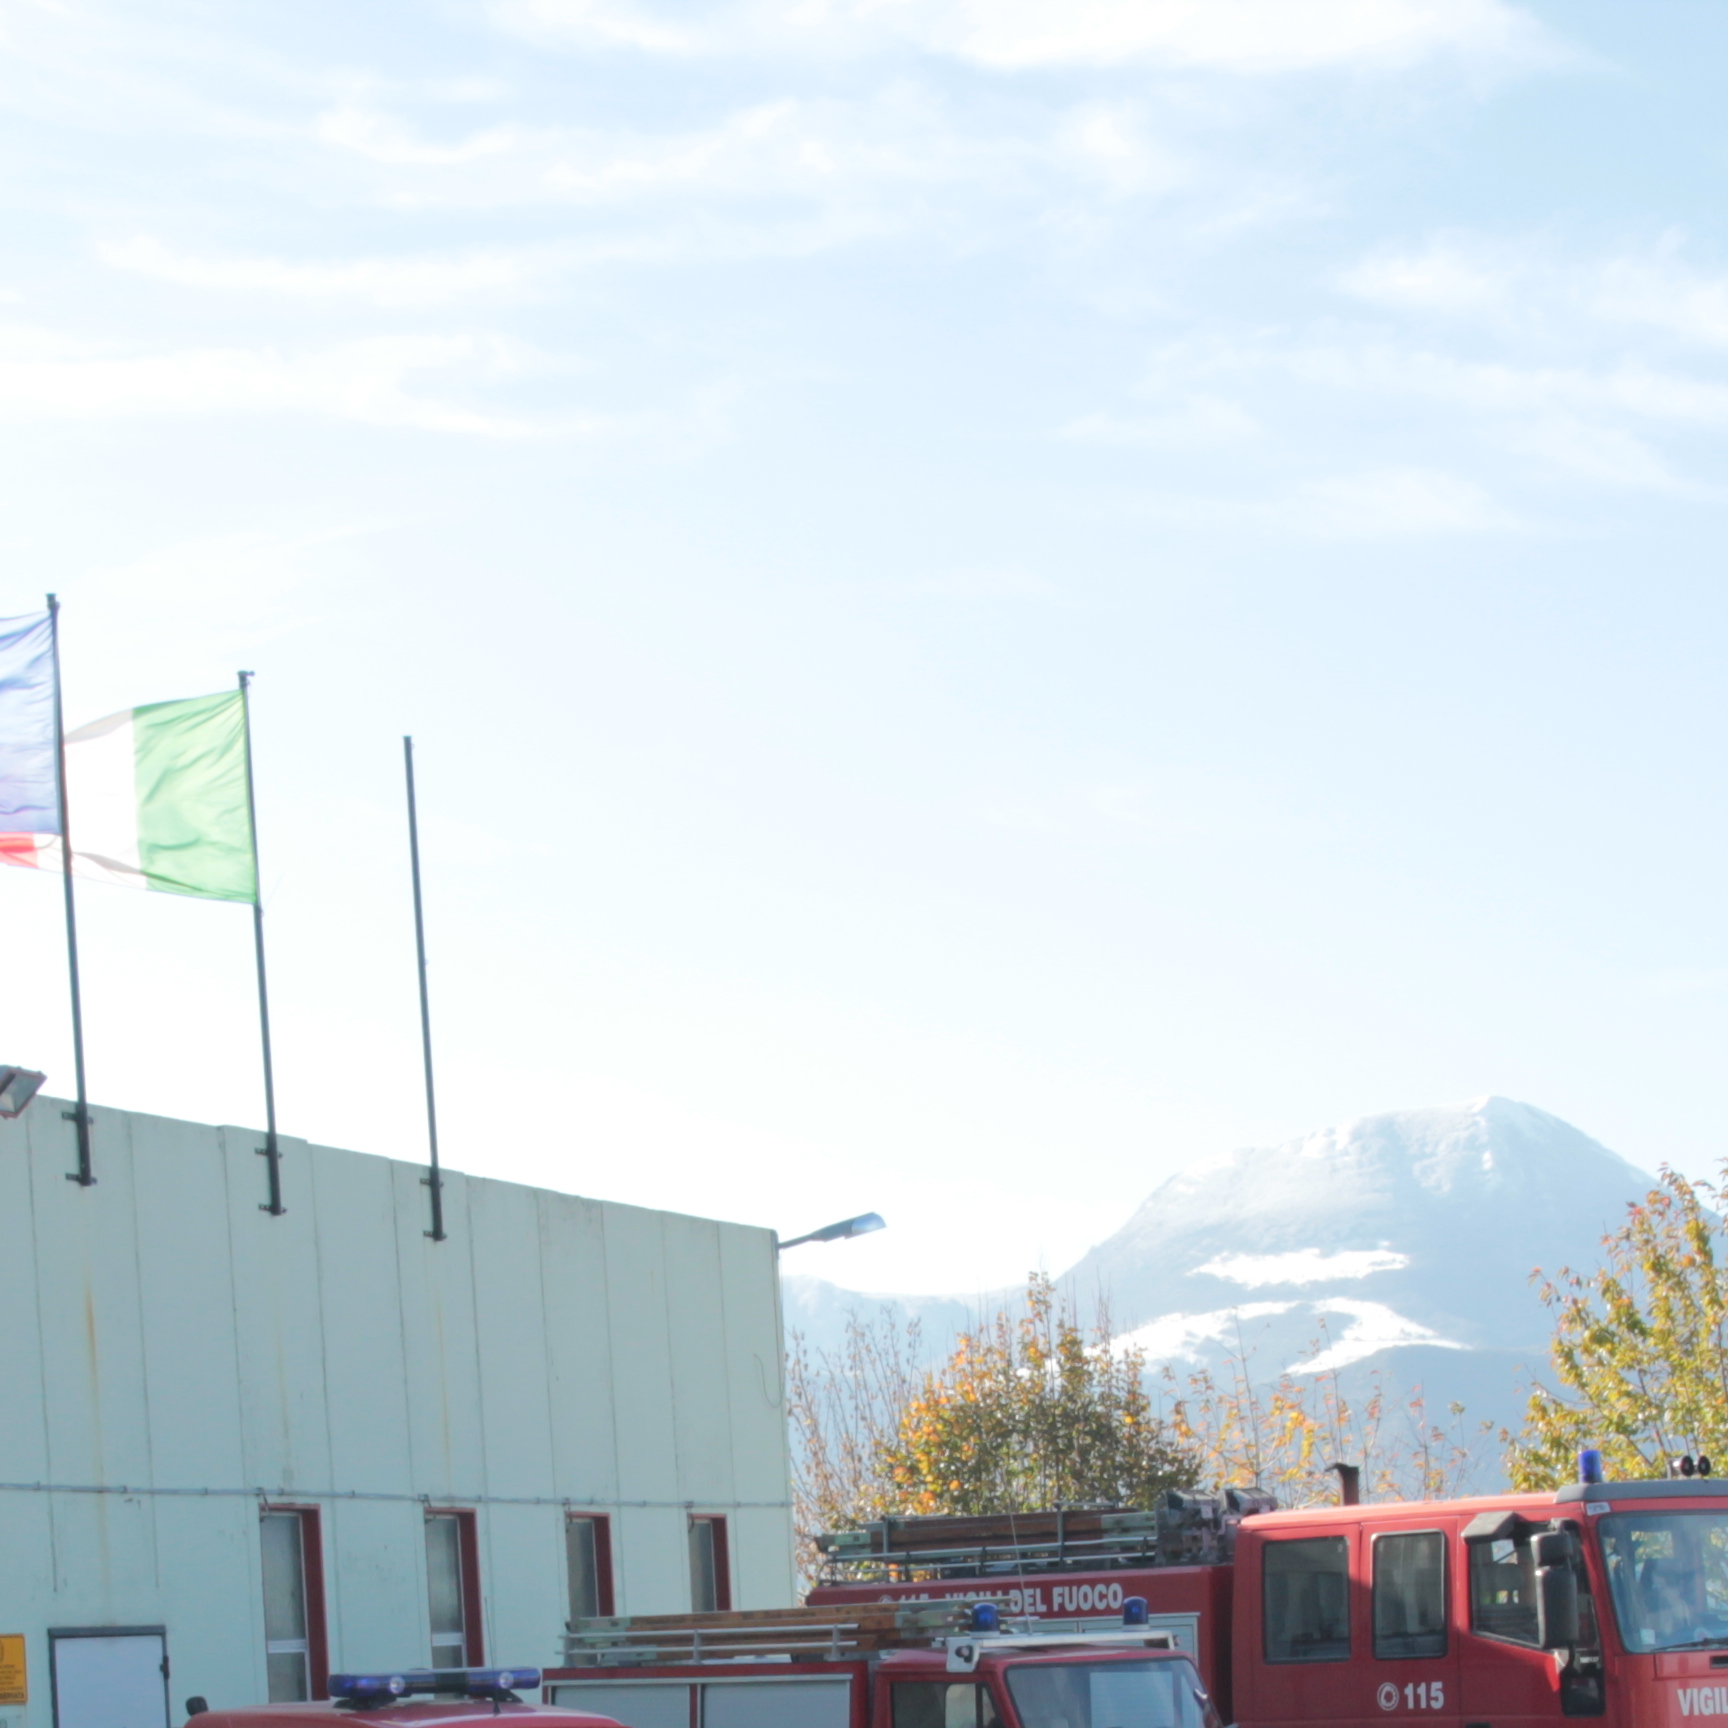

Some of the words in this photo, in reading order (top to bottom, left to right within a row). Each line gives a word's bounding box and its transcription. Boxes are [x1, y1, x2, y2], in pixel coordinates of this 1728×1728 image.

[1009, 1588, 1047, 1613] DEL
[1052, 1583, 1123, 1612] FUOCO
[1404, 1681, 1444, 1710] 115
